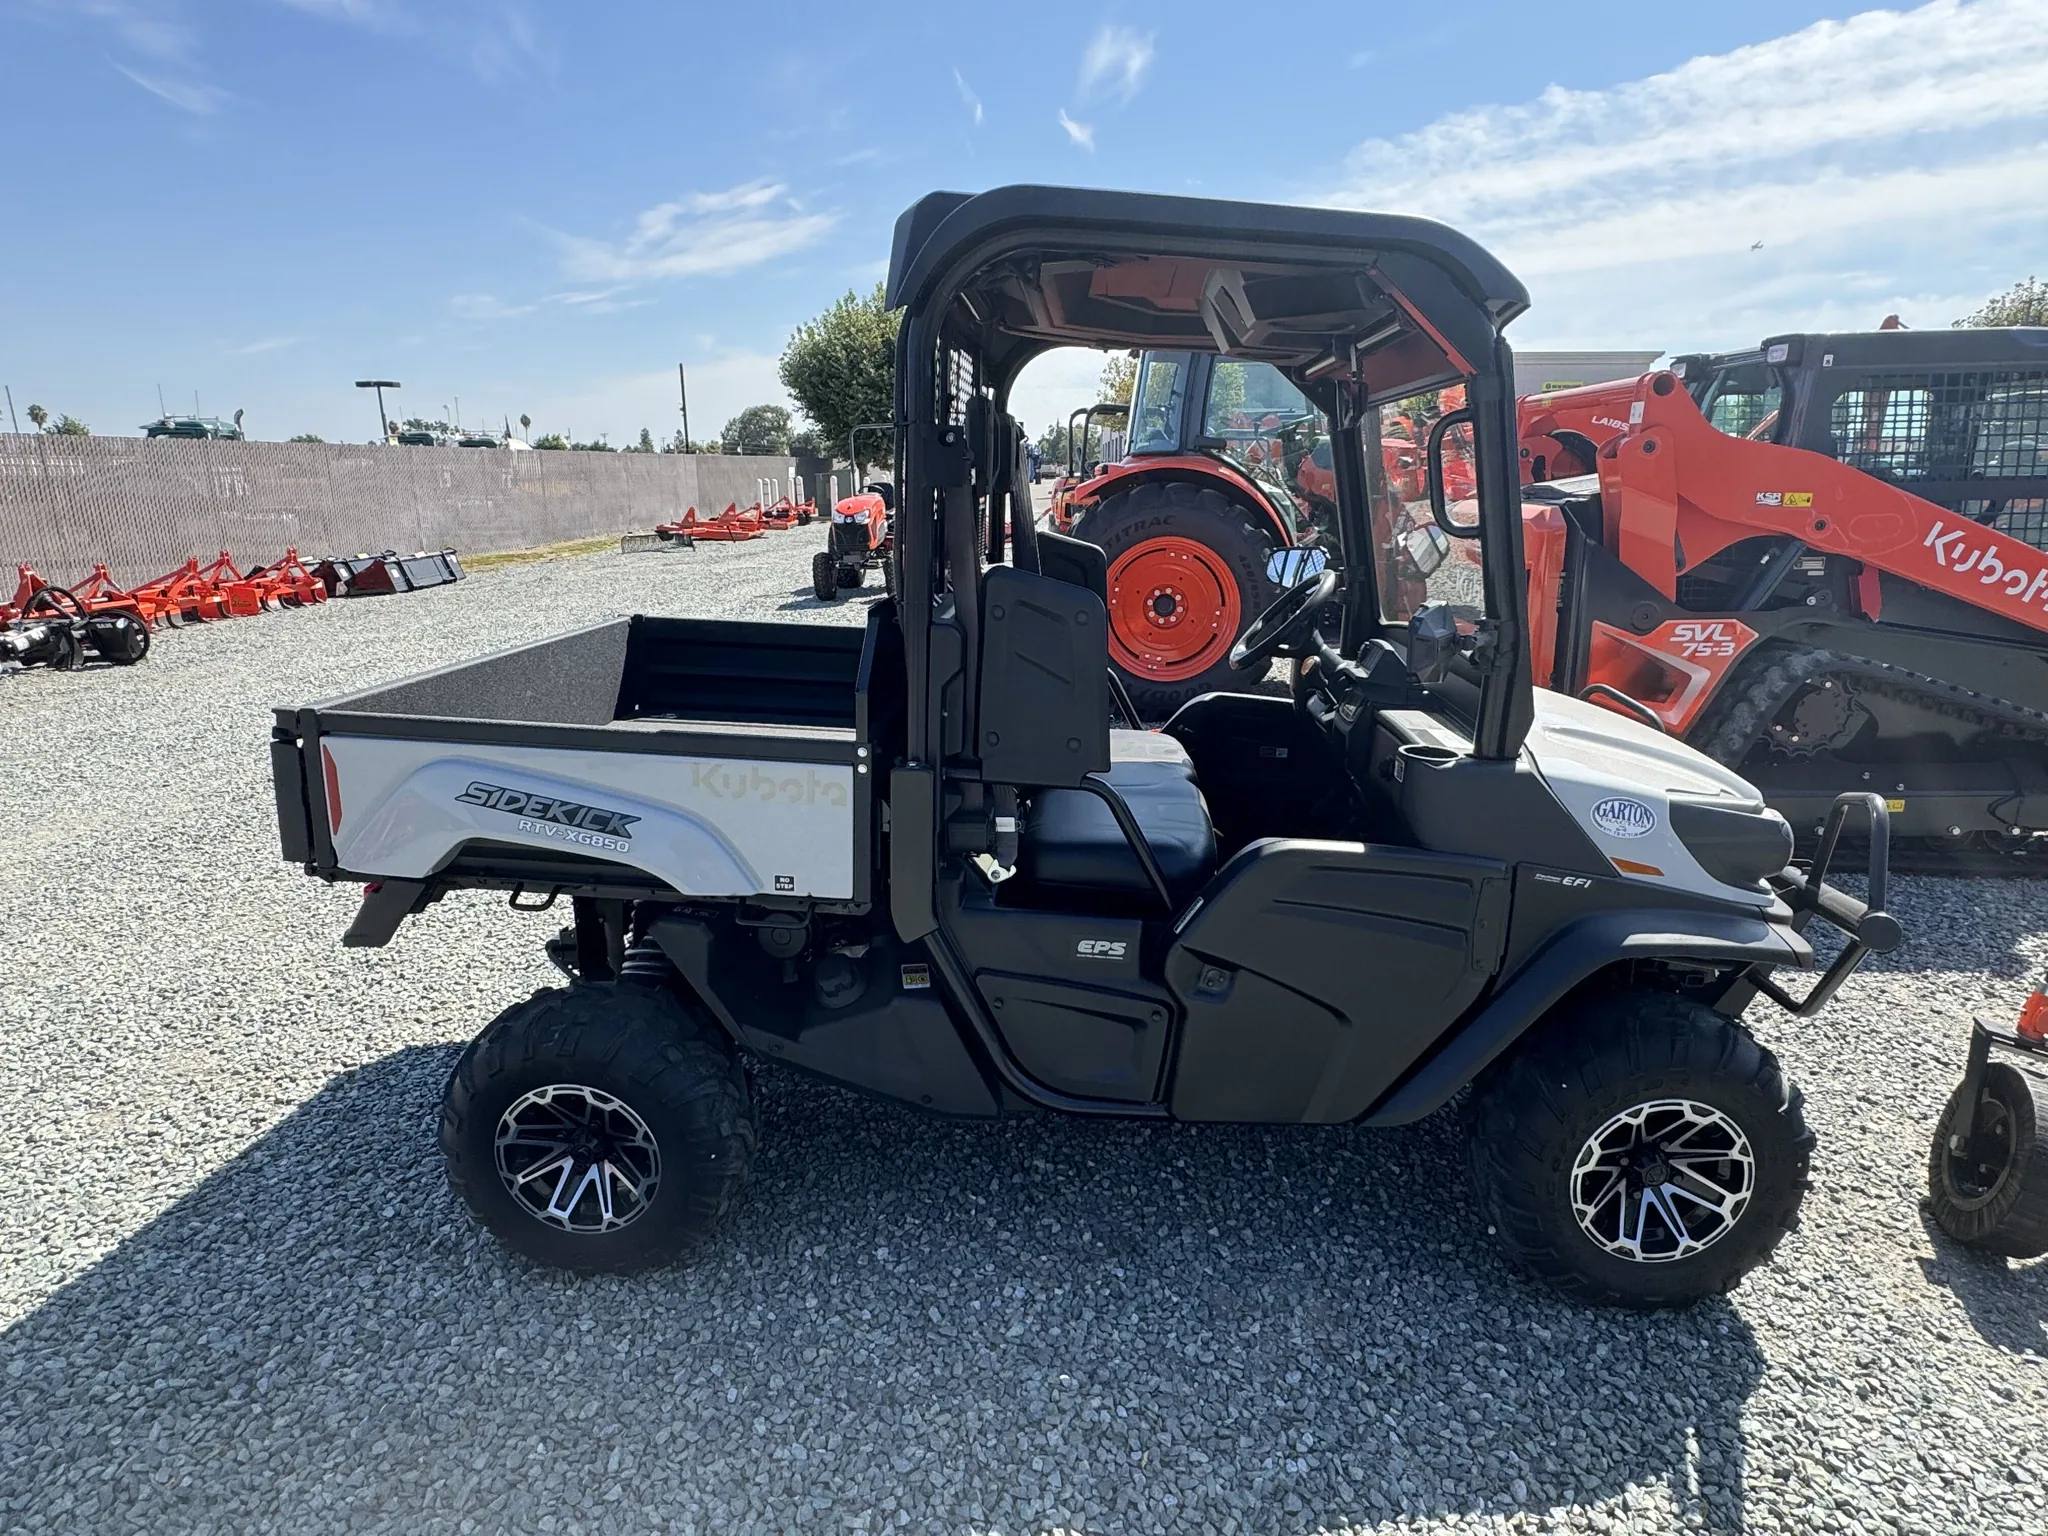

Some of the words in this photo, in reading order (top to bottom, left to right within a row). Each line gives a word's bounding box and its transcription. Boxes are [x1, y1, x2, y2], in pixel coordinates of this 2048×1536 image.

[1669, 623, 1732, 641] SVL
[1681, 642, 1735, 656] 75-3
[691, 762, 848, 807] Kubota
[455, 781, 642, 839] SIDEKICK
[1596, 801, 1652, 825] GARTON
[518, 819, 631, 853] RTV-XG850
[1562, 876, 1592, 888] EFI
[1077, 940, 1127, 955] EPS
